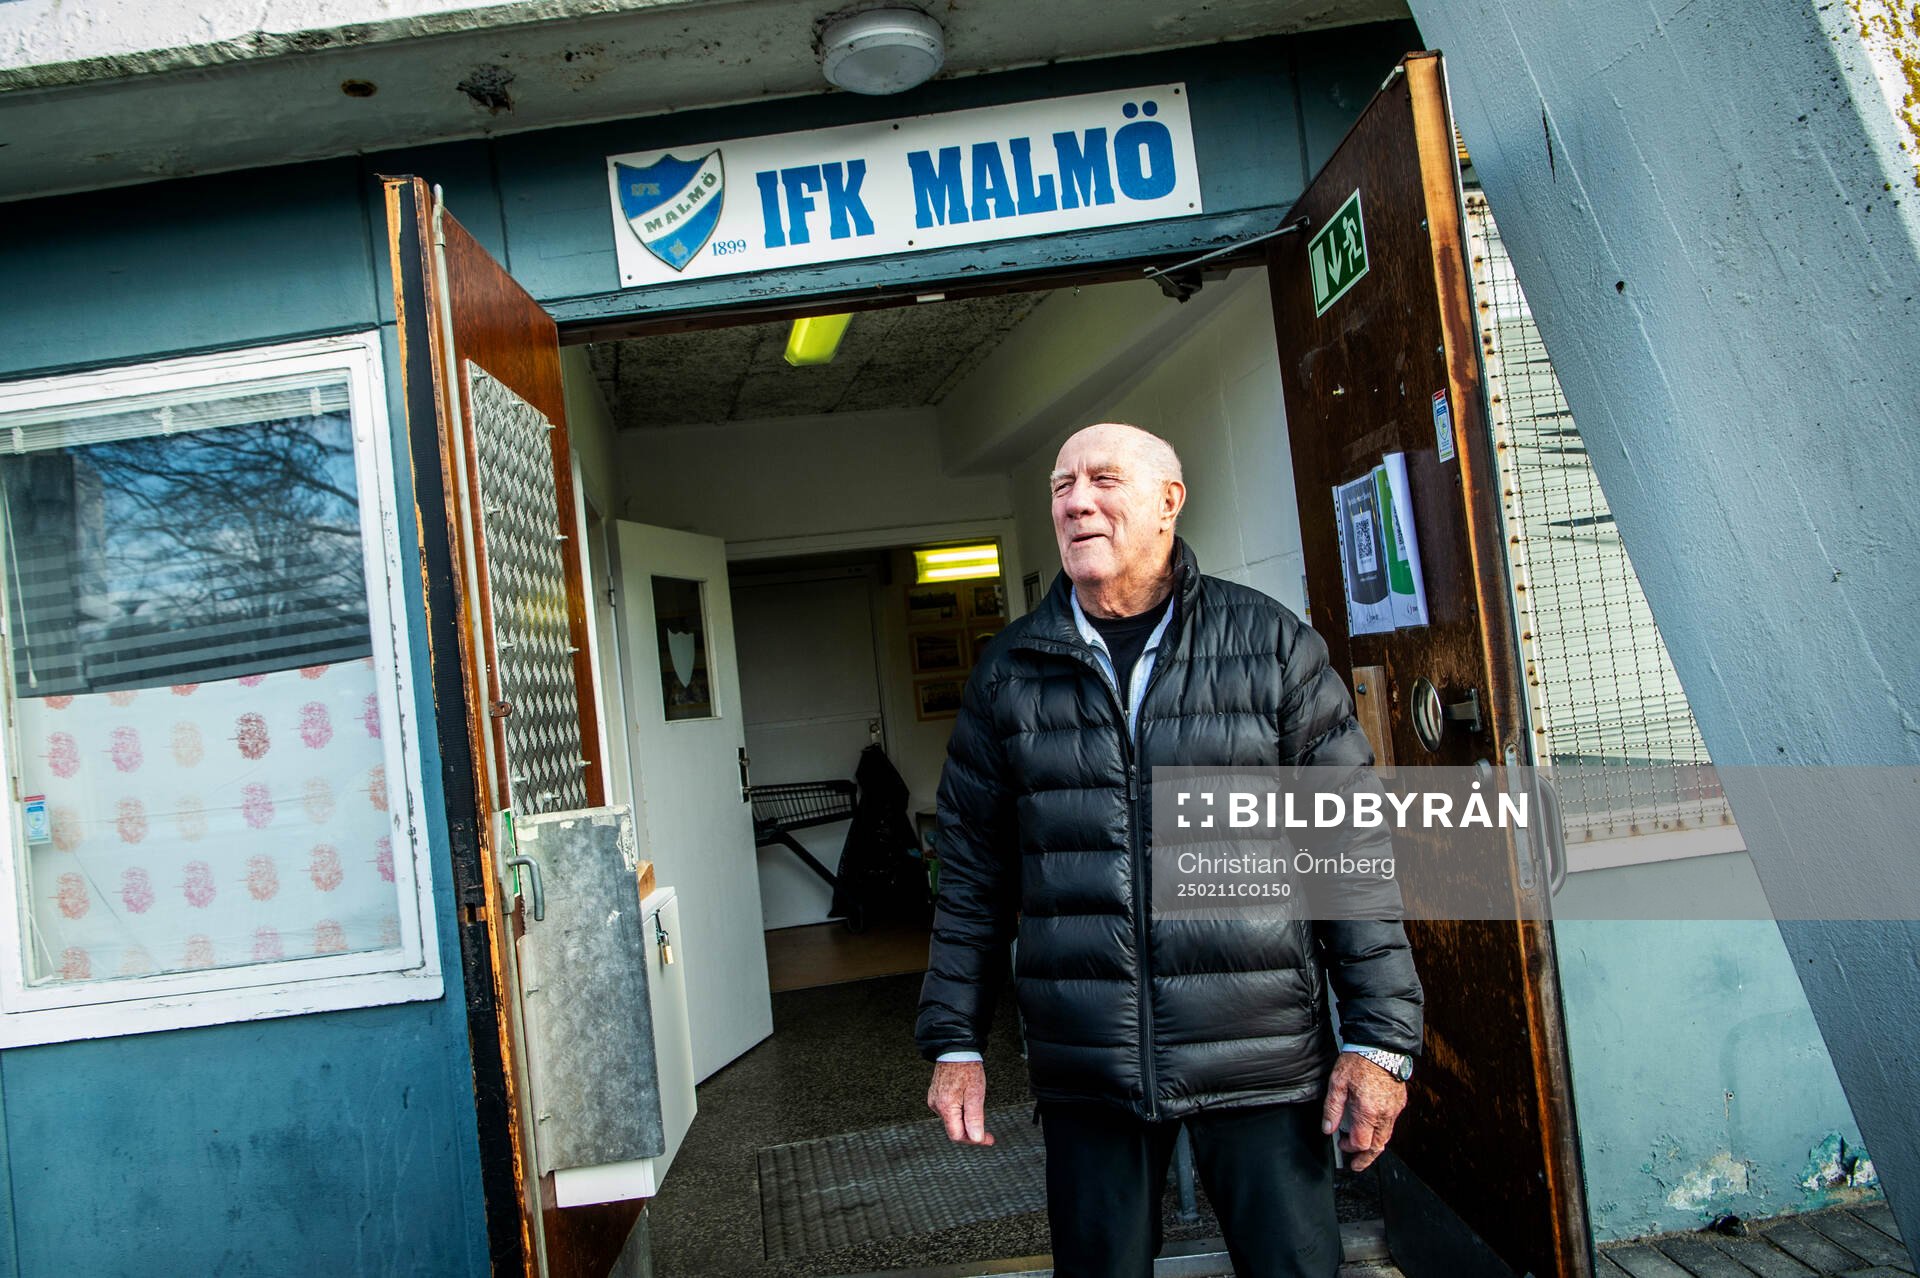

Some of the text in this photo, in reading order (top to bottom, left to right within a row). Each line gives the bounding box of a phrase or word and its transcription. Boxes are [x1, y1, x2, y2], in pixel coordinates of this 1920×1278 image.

[631, 183, 660, 196] IFK
[756, 101, 1177, 249] IFK MALMÖ
[644, 172, 717, 233] MALMÖ
[712, 239, 747, 256] 1899
